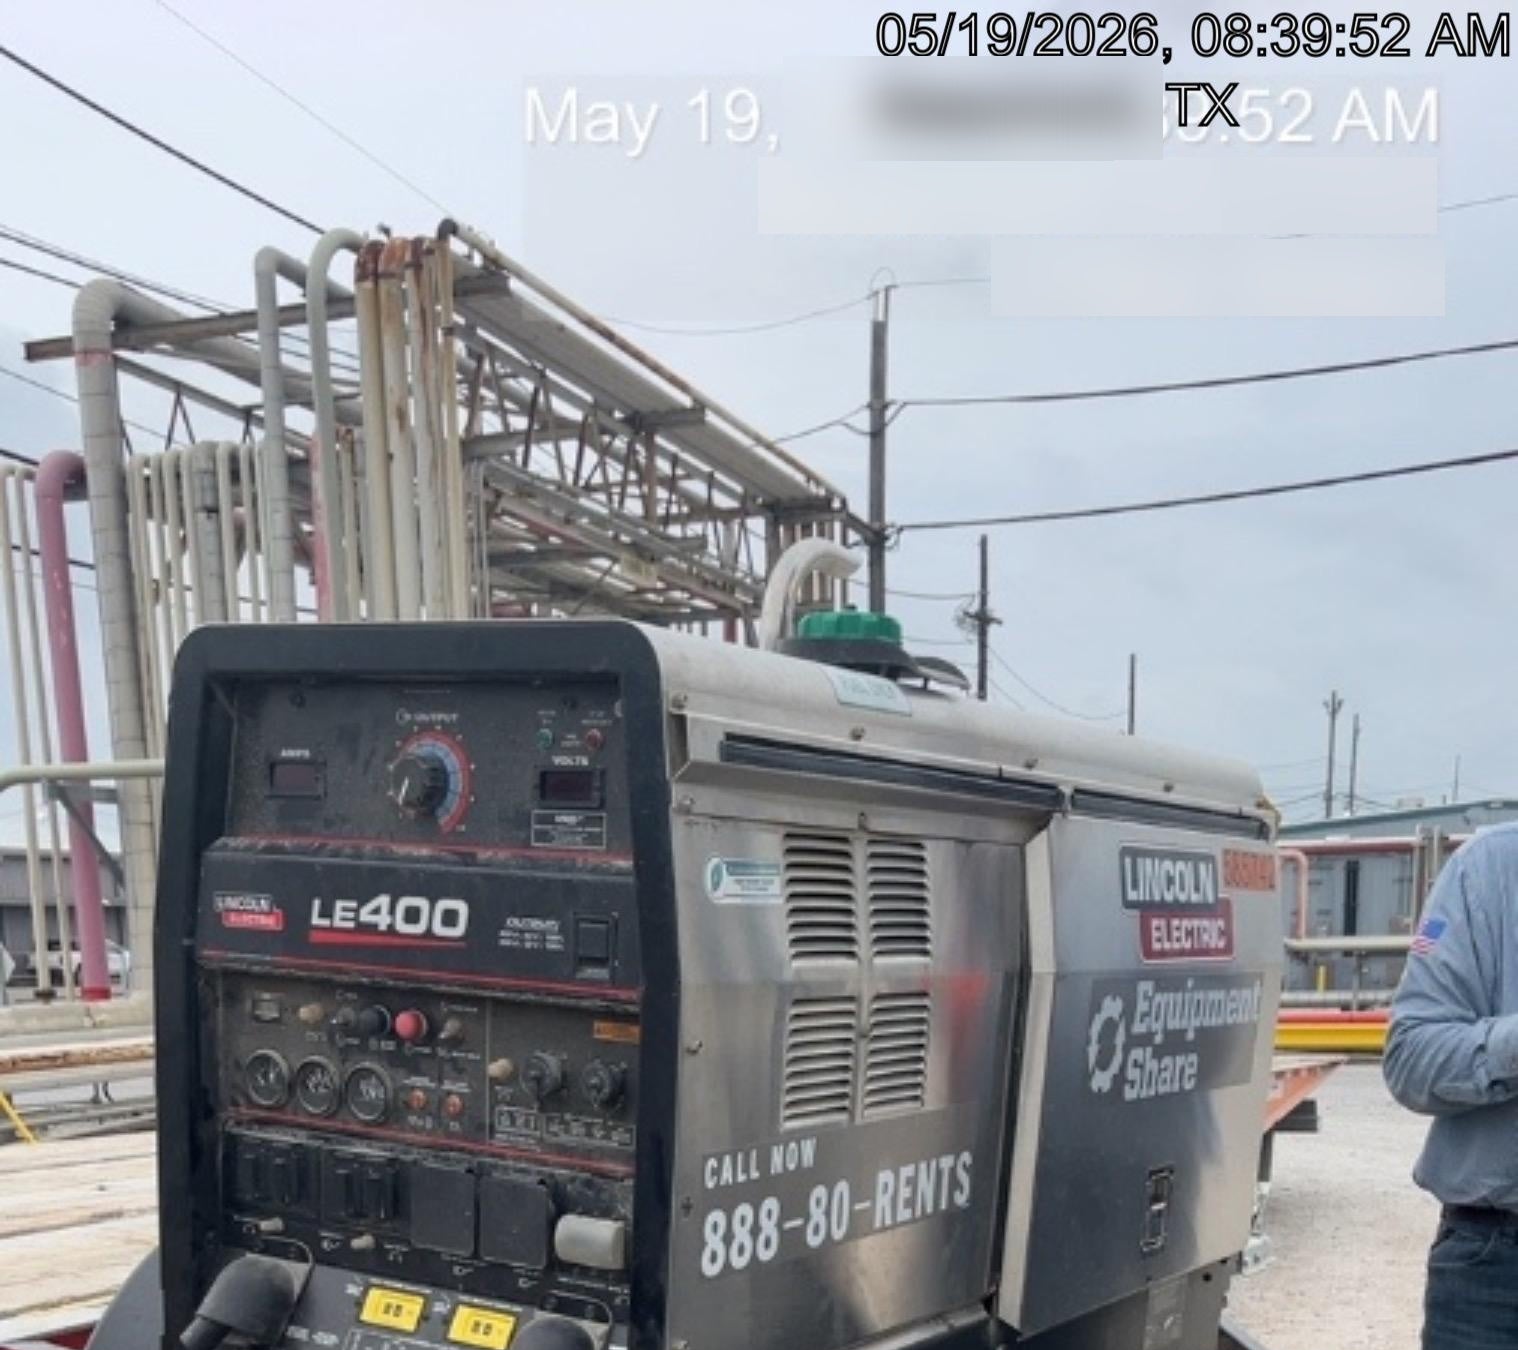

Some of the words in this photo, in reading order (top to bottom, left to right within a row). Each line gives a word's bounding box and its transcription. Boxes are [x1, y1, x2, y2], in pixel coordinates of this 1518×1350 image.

[1123, 857, 1214, 904] LINCOLN
[310, 893, 469, 938] LE400
[1151, 917, 1225, 951] ELECTRIC
[1131, 977, 1262, 1045] Equipment
[1124, 1047, 1198, 1101] Share
[704, 1150, 760, 1189] CALL
[770, 1136, 817, 1175] NOW
[700, 1150, 973, 1278] 888-80-RENTS
